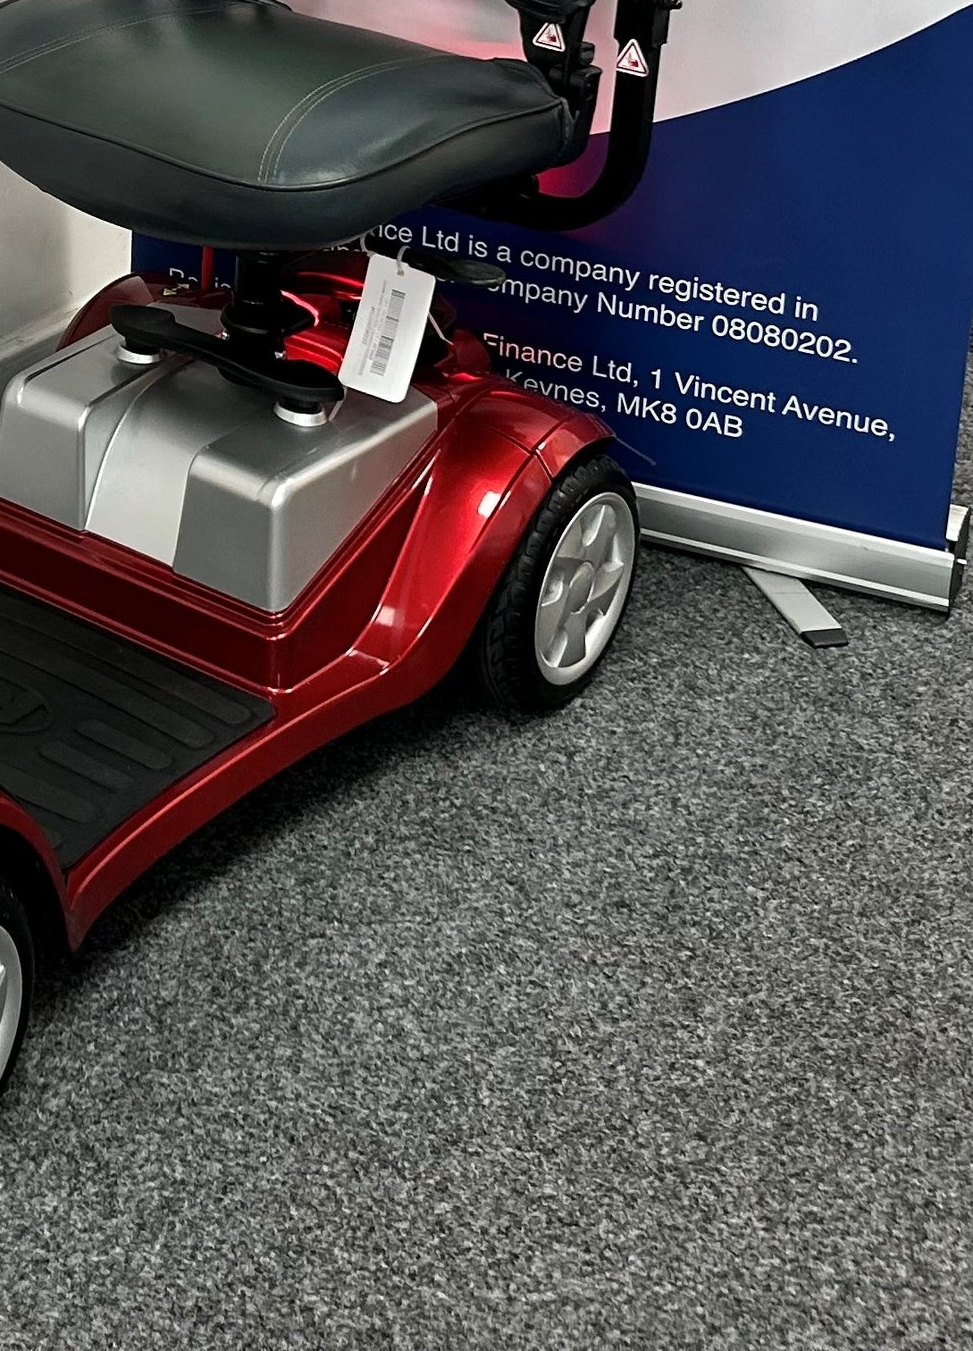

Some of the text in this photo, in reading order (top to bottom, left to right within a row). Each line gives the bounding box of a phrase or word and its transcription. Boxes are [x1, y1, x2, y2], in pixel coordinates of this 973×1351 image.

[422, 225, 459, 253] Ltd
[468, 234, 488, 258] is
[496, 245, 512, 263] a
[520, 250, 641, 292] company
[648, 273, 786, 316] registered
[794, 295, 819, 322] in
[487, 279, 858, 364] mpany Number 08080202.
[592, 355, 639, 388] Ltd,
[650, 368, 661, 390] 1
[674, 371, 777, 413] Vincent
[781, 395, 895, 442] Avenue,
[617, 392, 677, 425] MK8
[685, 407, 743, 438] 0AB
